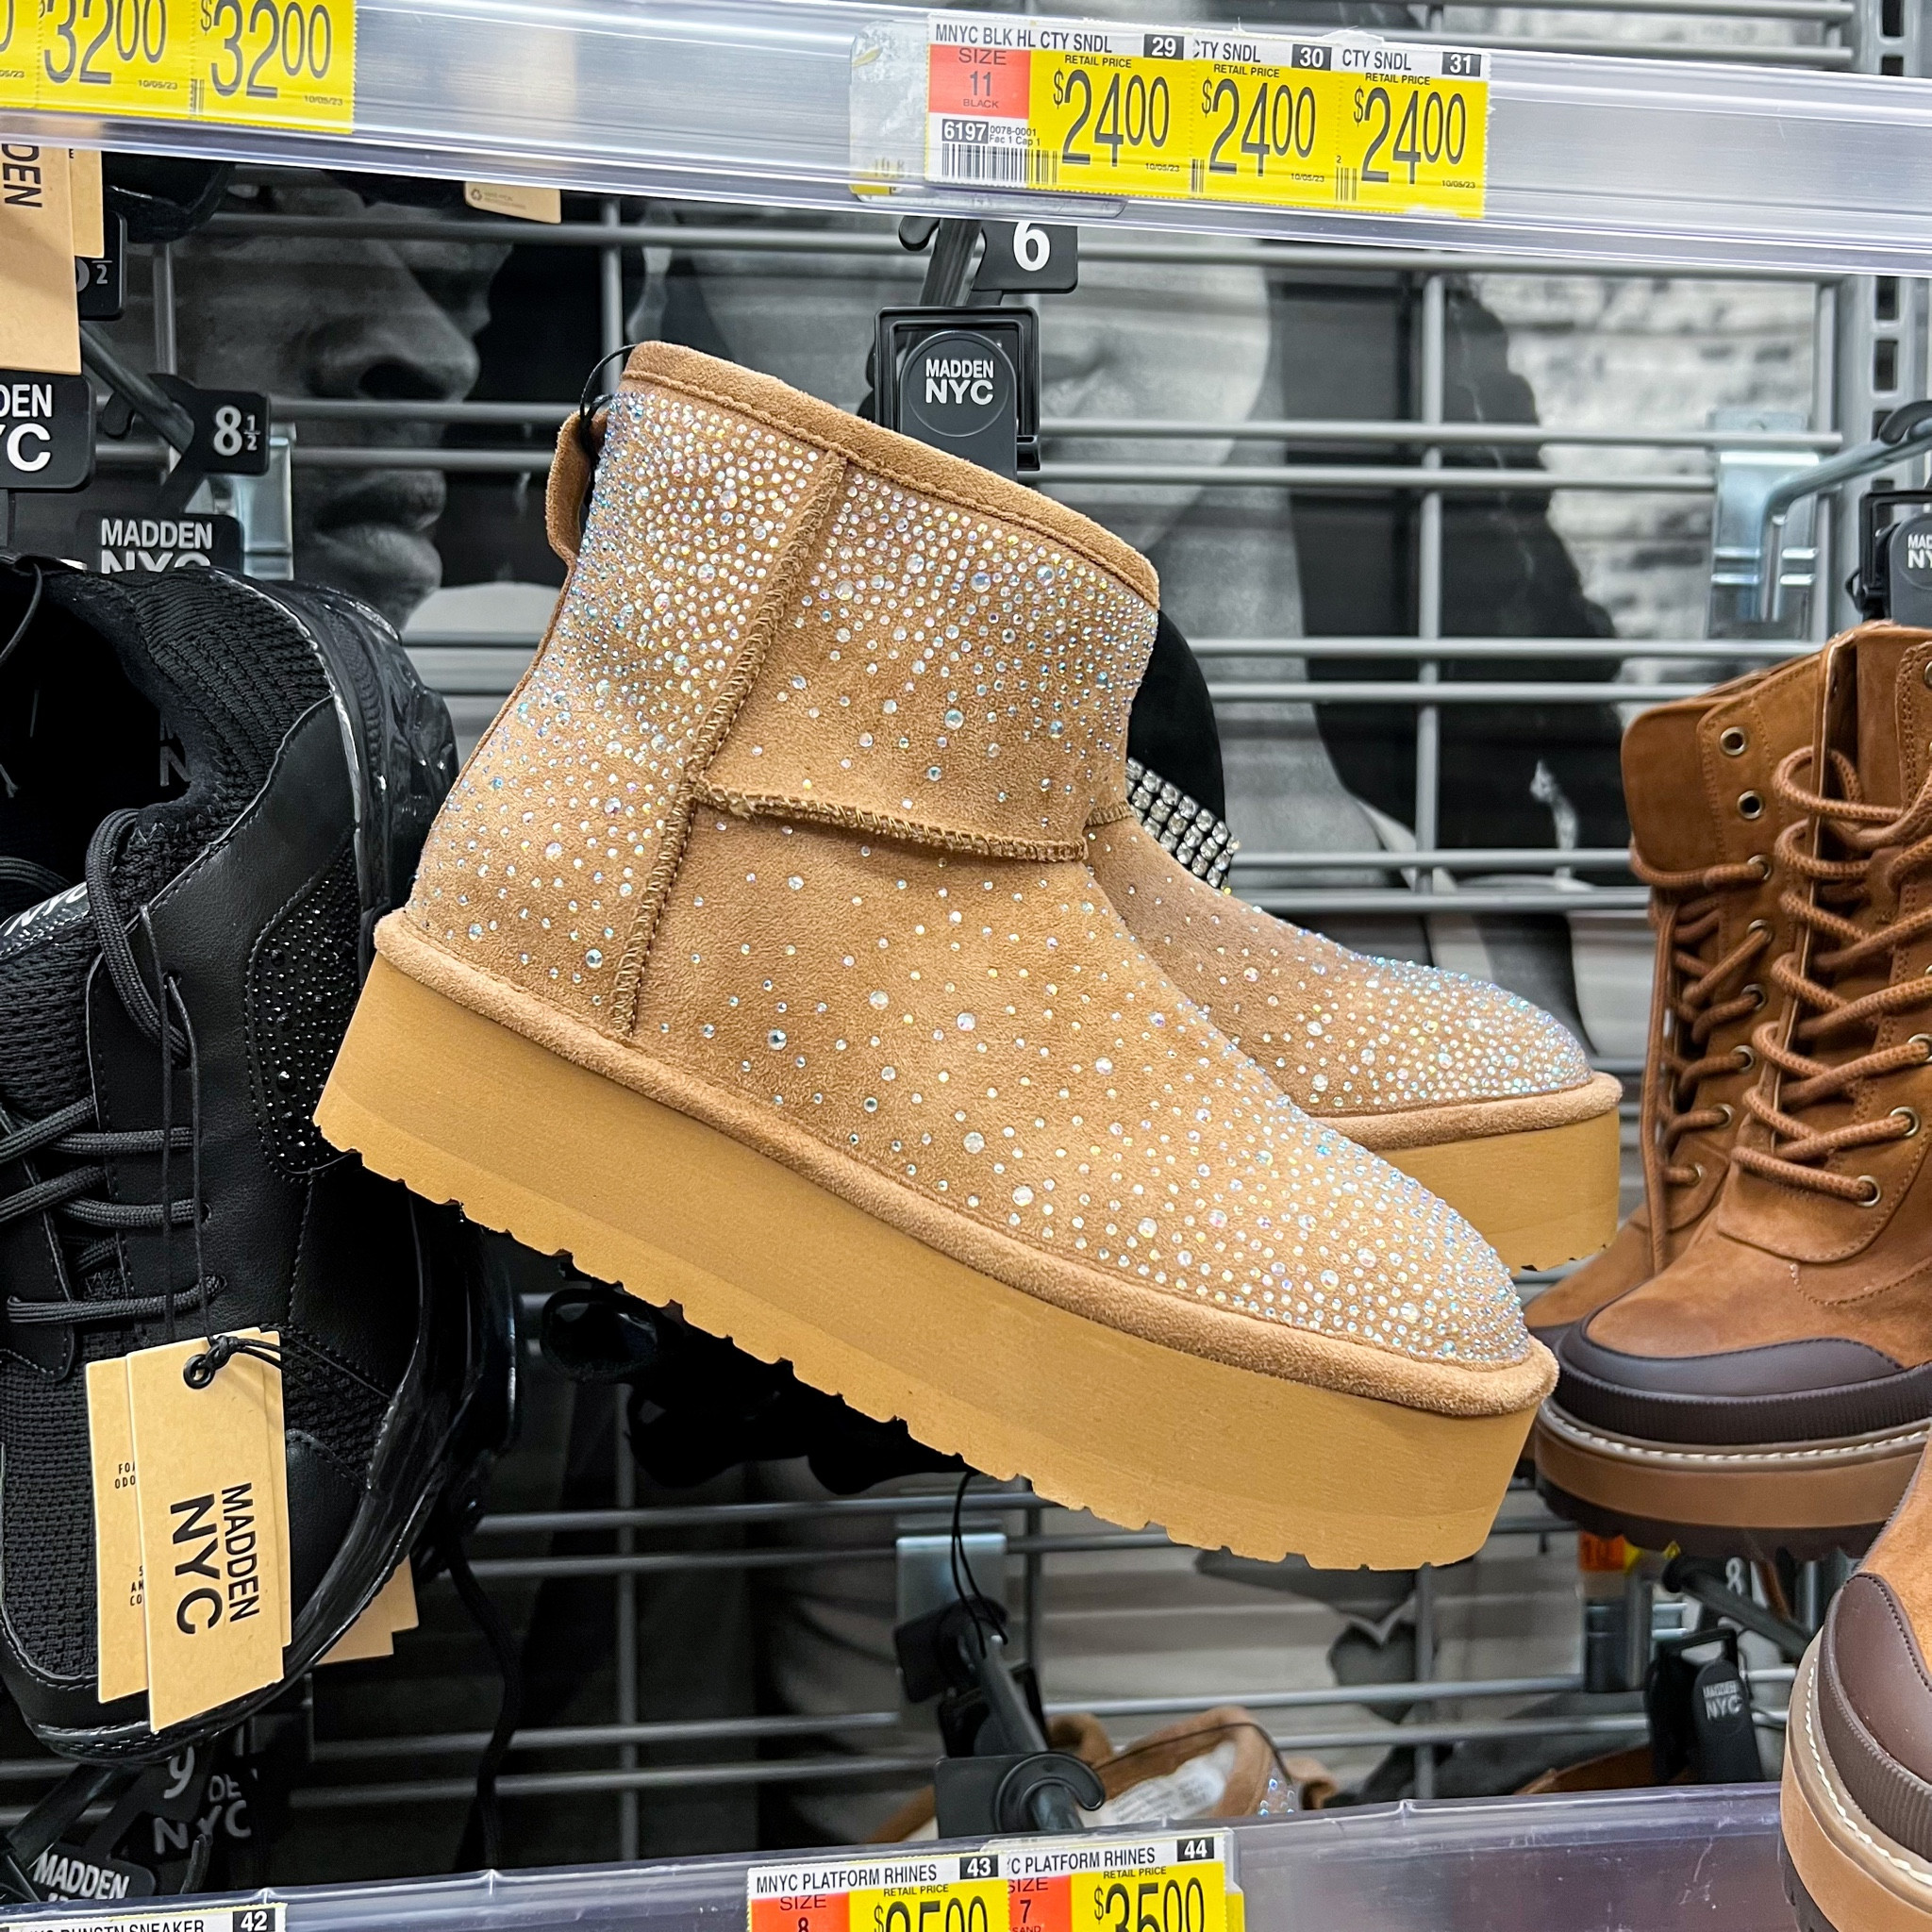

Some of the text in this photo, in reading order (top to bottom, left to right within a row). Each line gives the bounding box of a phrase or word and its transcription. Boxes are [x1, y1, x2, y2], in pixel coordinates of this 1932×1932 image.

[40, 0, 166, 85] 3200
[935, 24, 1112, 54] MNYC BLK HL CTY SNDL
[1151, 36, 1177, 58] 29
[958, 47, 1007, 66] SIZE
[1065, 55, 1132, 69] RETAIL PRICE
[1223, 42, 1261, 63] SNDL
[1299, 46, 1324, 68] 30
[1342, 48, 1411, 71] CTY SNDL
[1213, 63, 1280, 78] RETAIL PRICE
[1449, 53, 1472, 74] 31
[970, 71, 991, 97] 11
[1365, 73, 1431, 86] RETAIL PRICE
[963, 98, 999, 109] BLACK
[943, 122, 987, 142] 6197
[990, 125, 1037, 137] 0078-0001
[1013, 222, 1051, 272] 6
[925, 358, 994, 378] MADDEN
[924, 377, 994, 406] NYC
[101, 518, 213, 550] MADDEN
[221, 1482, 260, 1624] MADDEN
[170, 1493, 224, 1635] NYC
[1184, 1840, 1208, 1857] 44
[966, 1857, 991, 1876] 43
[1025, 1852, 1100, 1874] PLATFORM
[1104, 1847, 1156, 1867] RHINES
[33, 1853, 130, 1900] MADDEN
[757, 1864, 937, 1893] MNYC PLATFORM RHINES
[1103, 1866, 1167, 1879] RETAIL PRICE
[883, 1883, 949, 1897] RETAIL PRICE
[779, 1894, 827, 1911] SIZE
[1020, 1899, 1032, 1924] 7
[241, 1911, 268, 1931] 42
